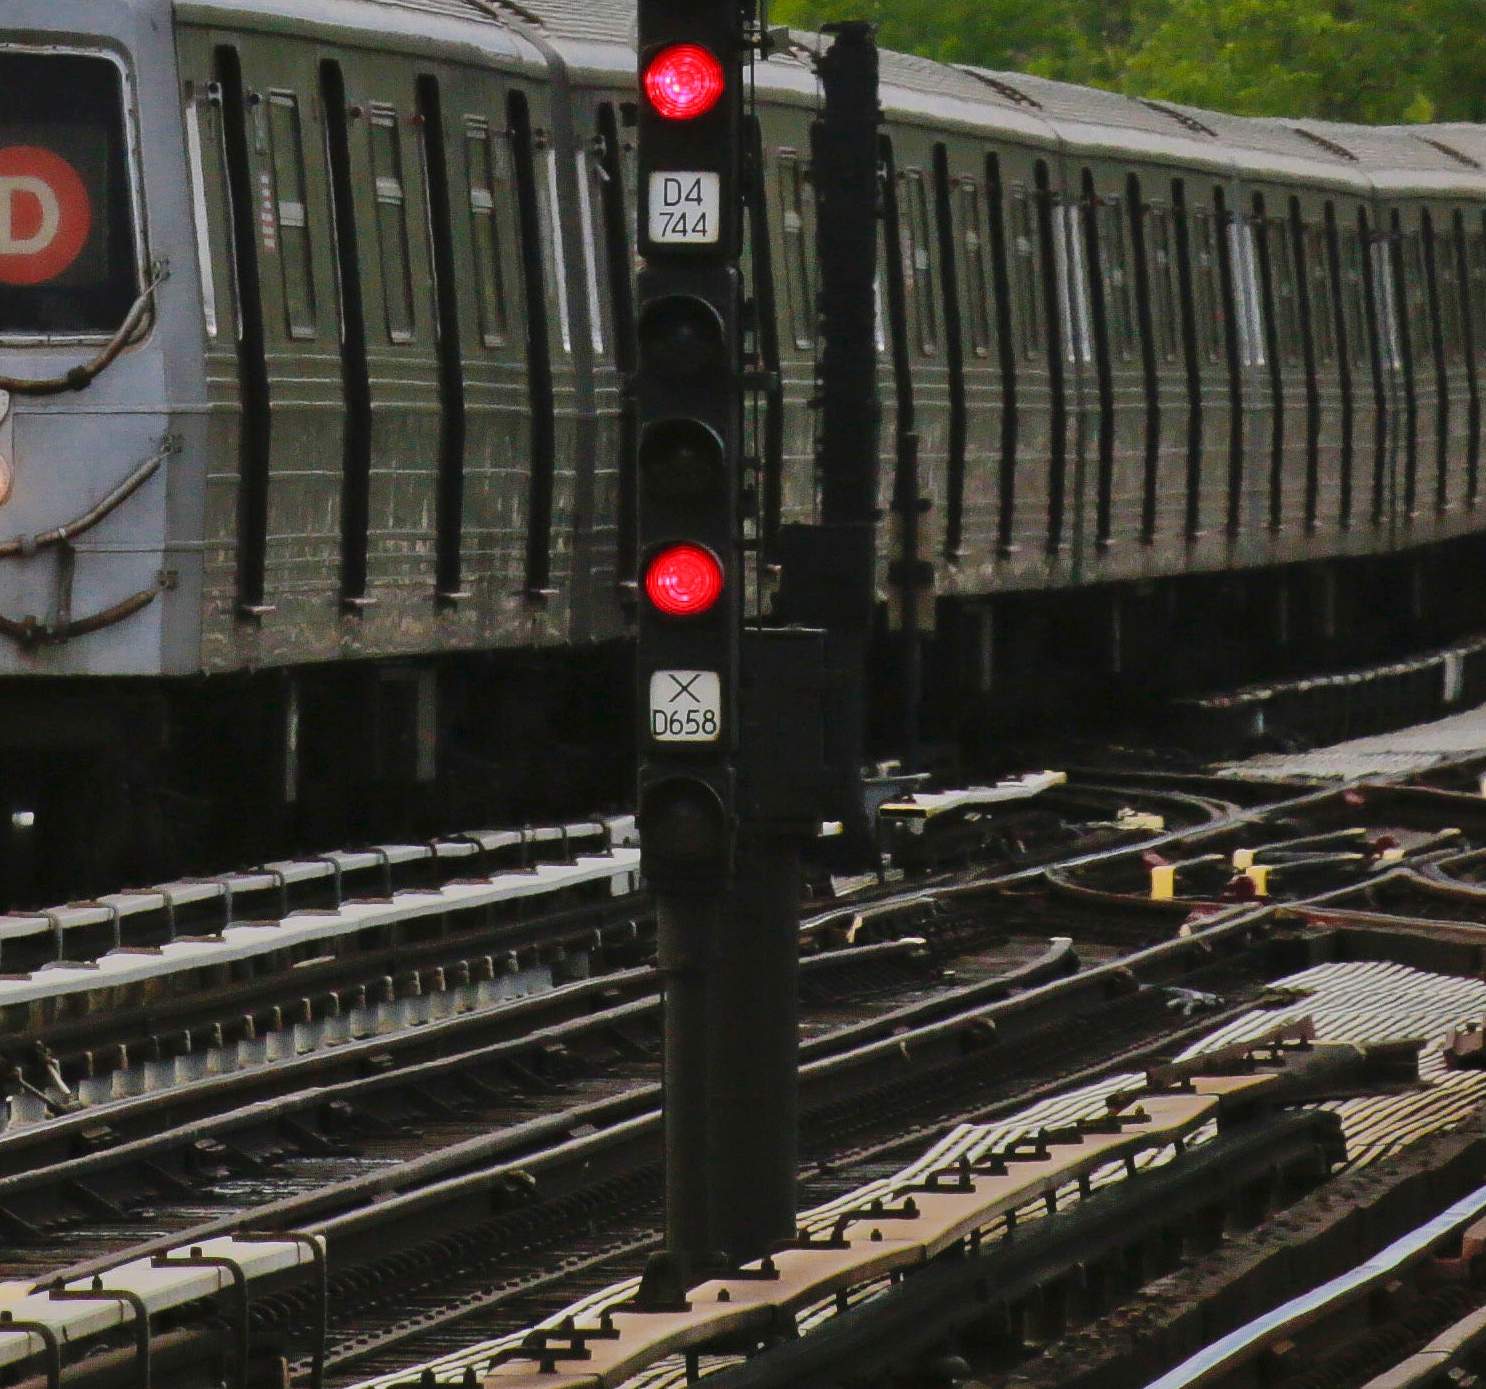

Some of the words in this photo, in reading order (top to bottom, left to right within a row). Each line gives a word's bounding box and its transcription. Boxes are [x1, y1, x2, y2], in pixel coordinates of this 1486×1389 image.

[664, 178, 703, 206] D4
[659, 212, 708, 237] 744
[653, 709, 717, 735] D658
